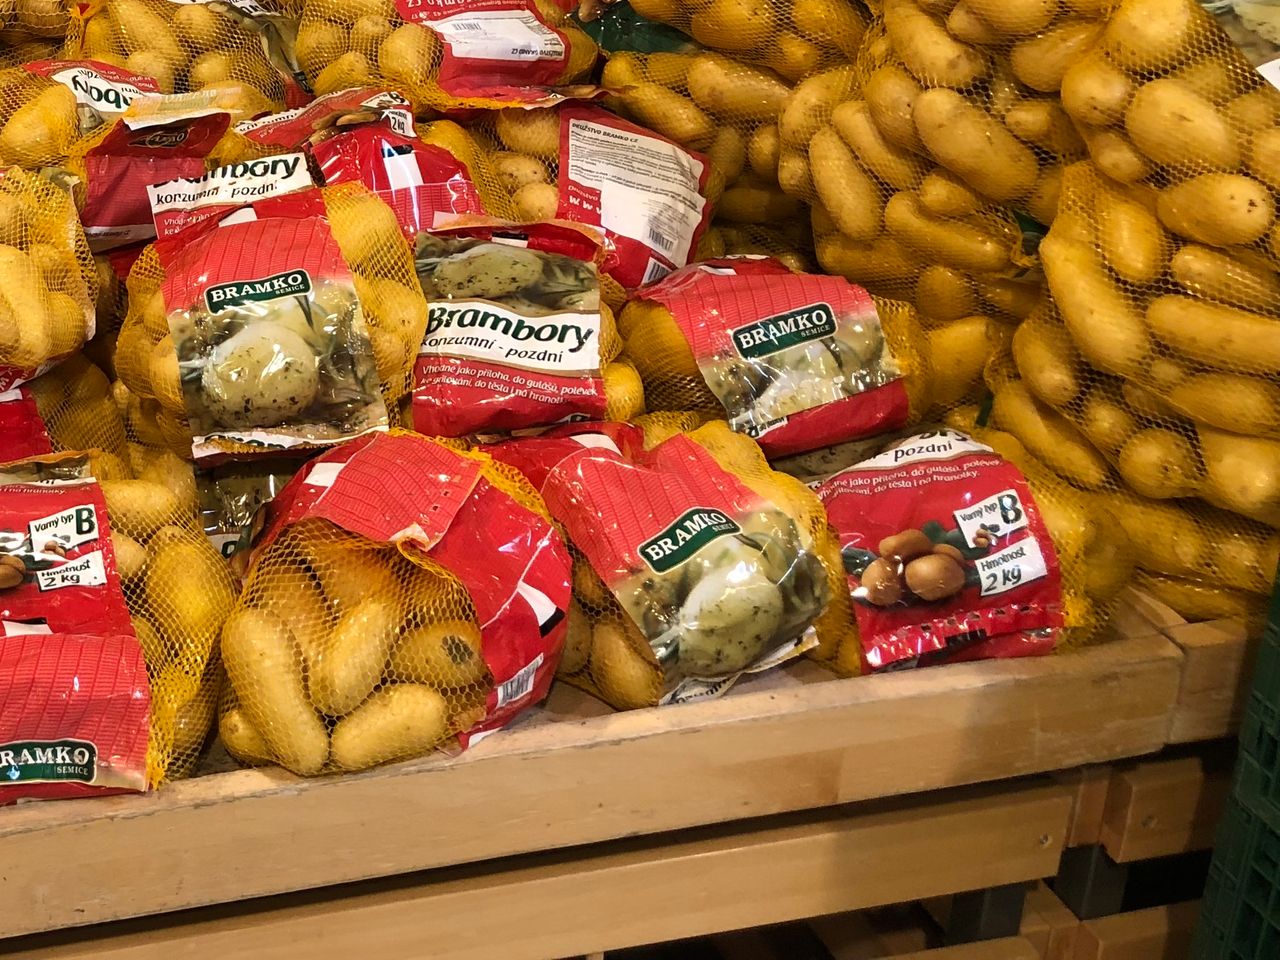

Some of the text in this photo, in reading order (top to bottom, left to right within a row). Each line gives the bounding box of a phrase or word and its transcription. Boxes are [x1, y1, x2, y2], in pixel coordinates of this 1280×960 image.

[210, 273, 303, 303] BRAMKO
[275, 283, 306, 295] SEMICE
[425, 306, 594, 353] Brambory
[739, 309, 828, 350] BRAMKO
[800, 324, 831, 338] SEMICE
[421, 335, 564, 363] konzumní pozdní
[456, 366, 477, 378] jako
[512, 374, 526, 385] do
[474, 379, 487, 389] do
[487, 381, 510, 394] těsta
[893, 440, 954, 463] pozdní
[848, 476, 871, 488] jako
[910, 465, 925, 477] do
[918, 476, 932, 486] na
[34, 506, 96, 536] Varný typ B
[959, 493, 1022, 525] Varný typ B
[645, 510, 727, 561] BRAMKO
[979, 546, 1027, 572] Hmotnost
[43, 573, 81, 587] 2 kg
[984, 566, 1022, 592] 2 kg
[56, 765, 89, 776] SEMICE
